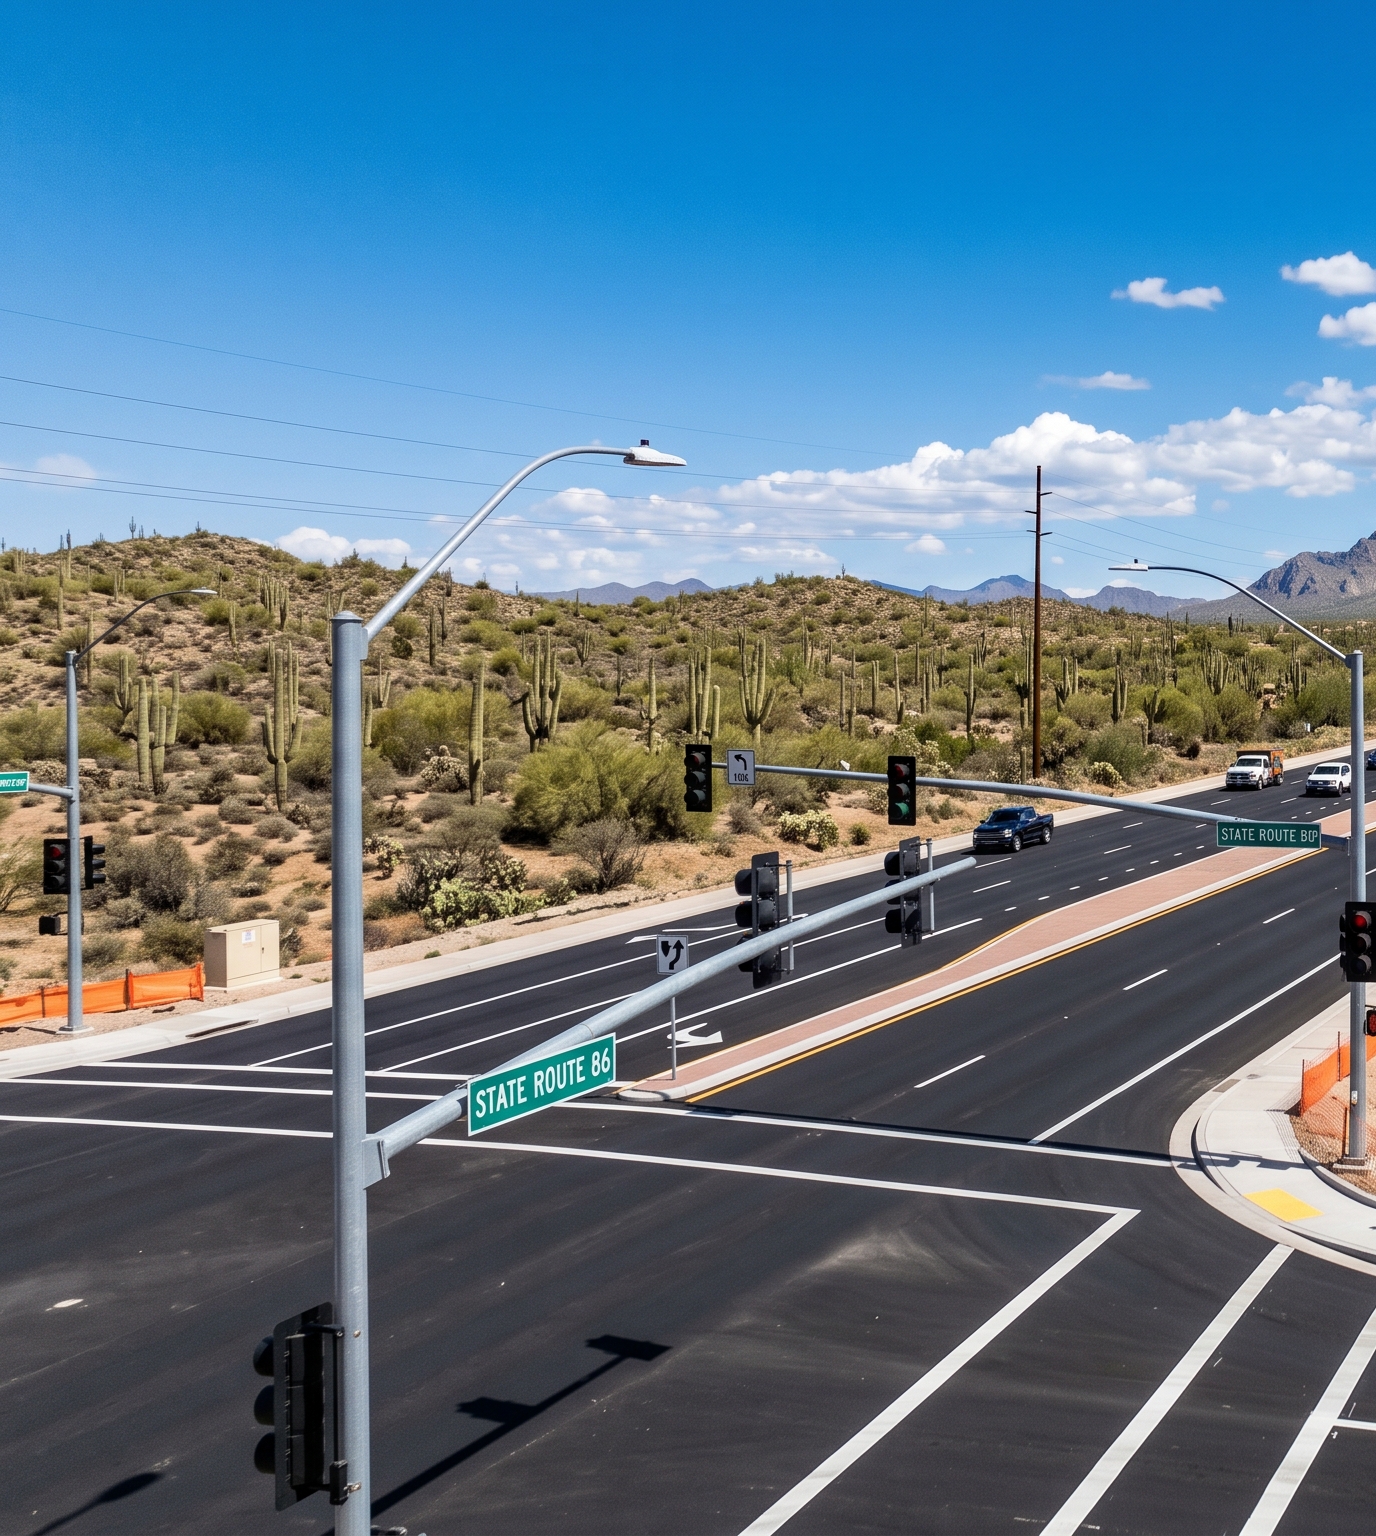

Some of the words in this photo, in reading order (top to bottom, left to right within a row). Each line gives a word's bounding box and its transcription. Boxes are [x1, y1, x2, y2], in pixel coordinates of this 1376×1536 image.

[1221, 828, 1255, 841] STATE
[1259, 828, 1297, 842] ROUTE
[475, 1075, 527, 1118] STATE
[533, 1055, 586, 1098] ROUTE
[591, 1047, 611, 1077] 86
